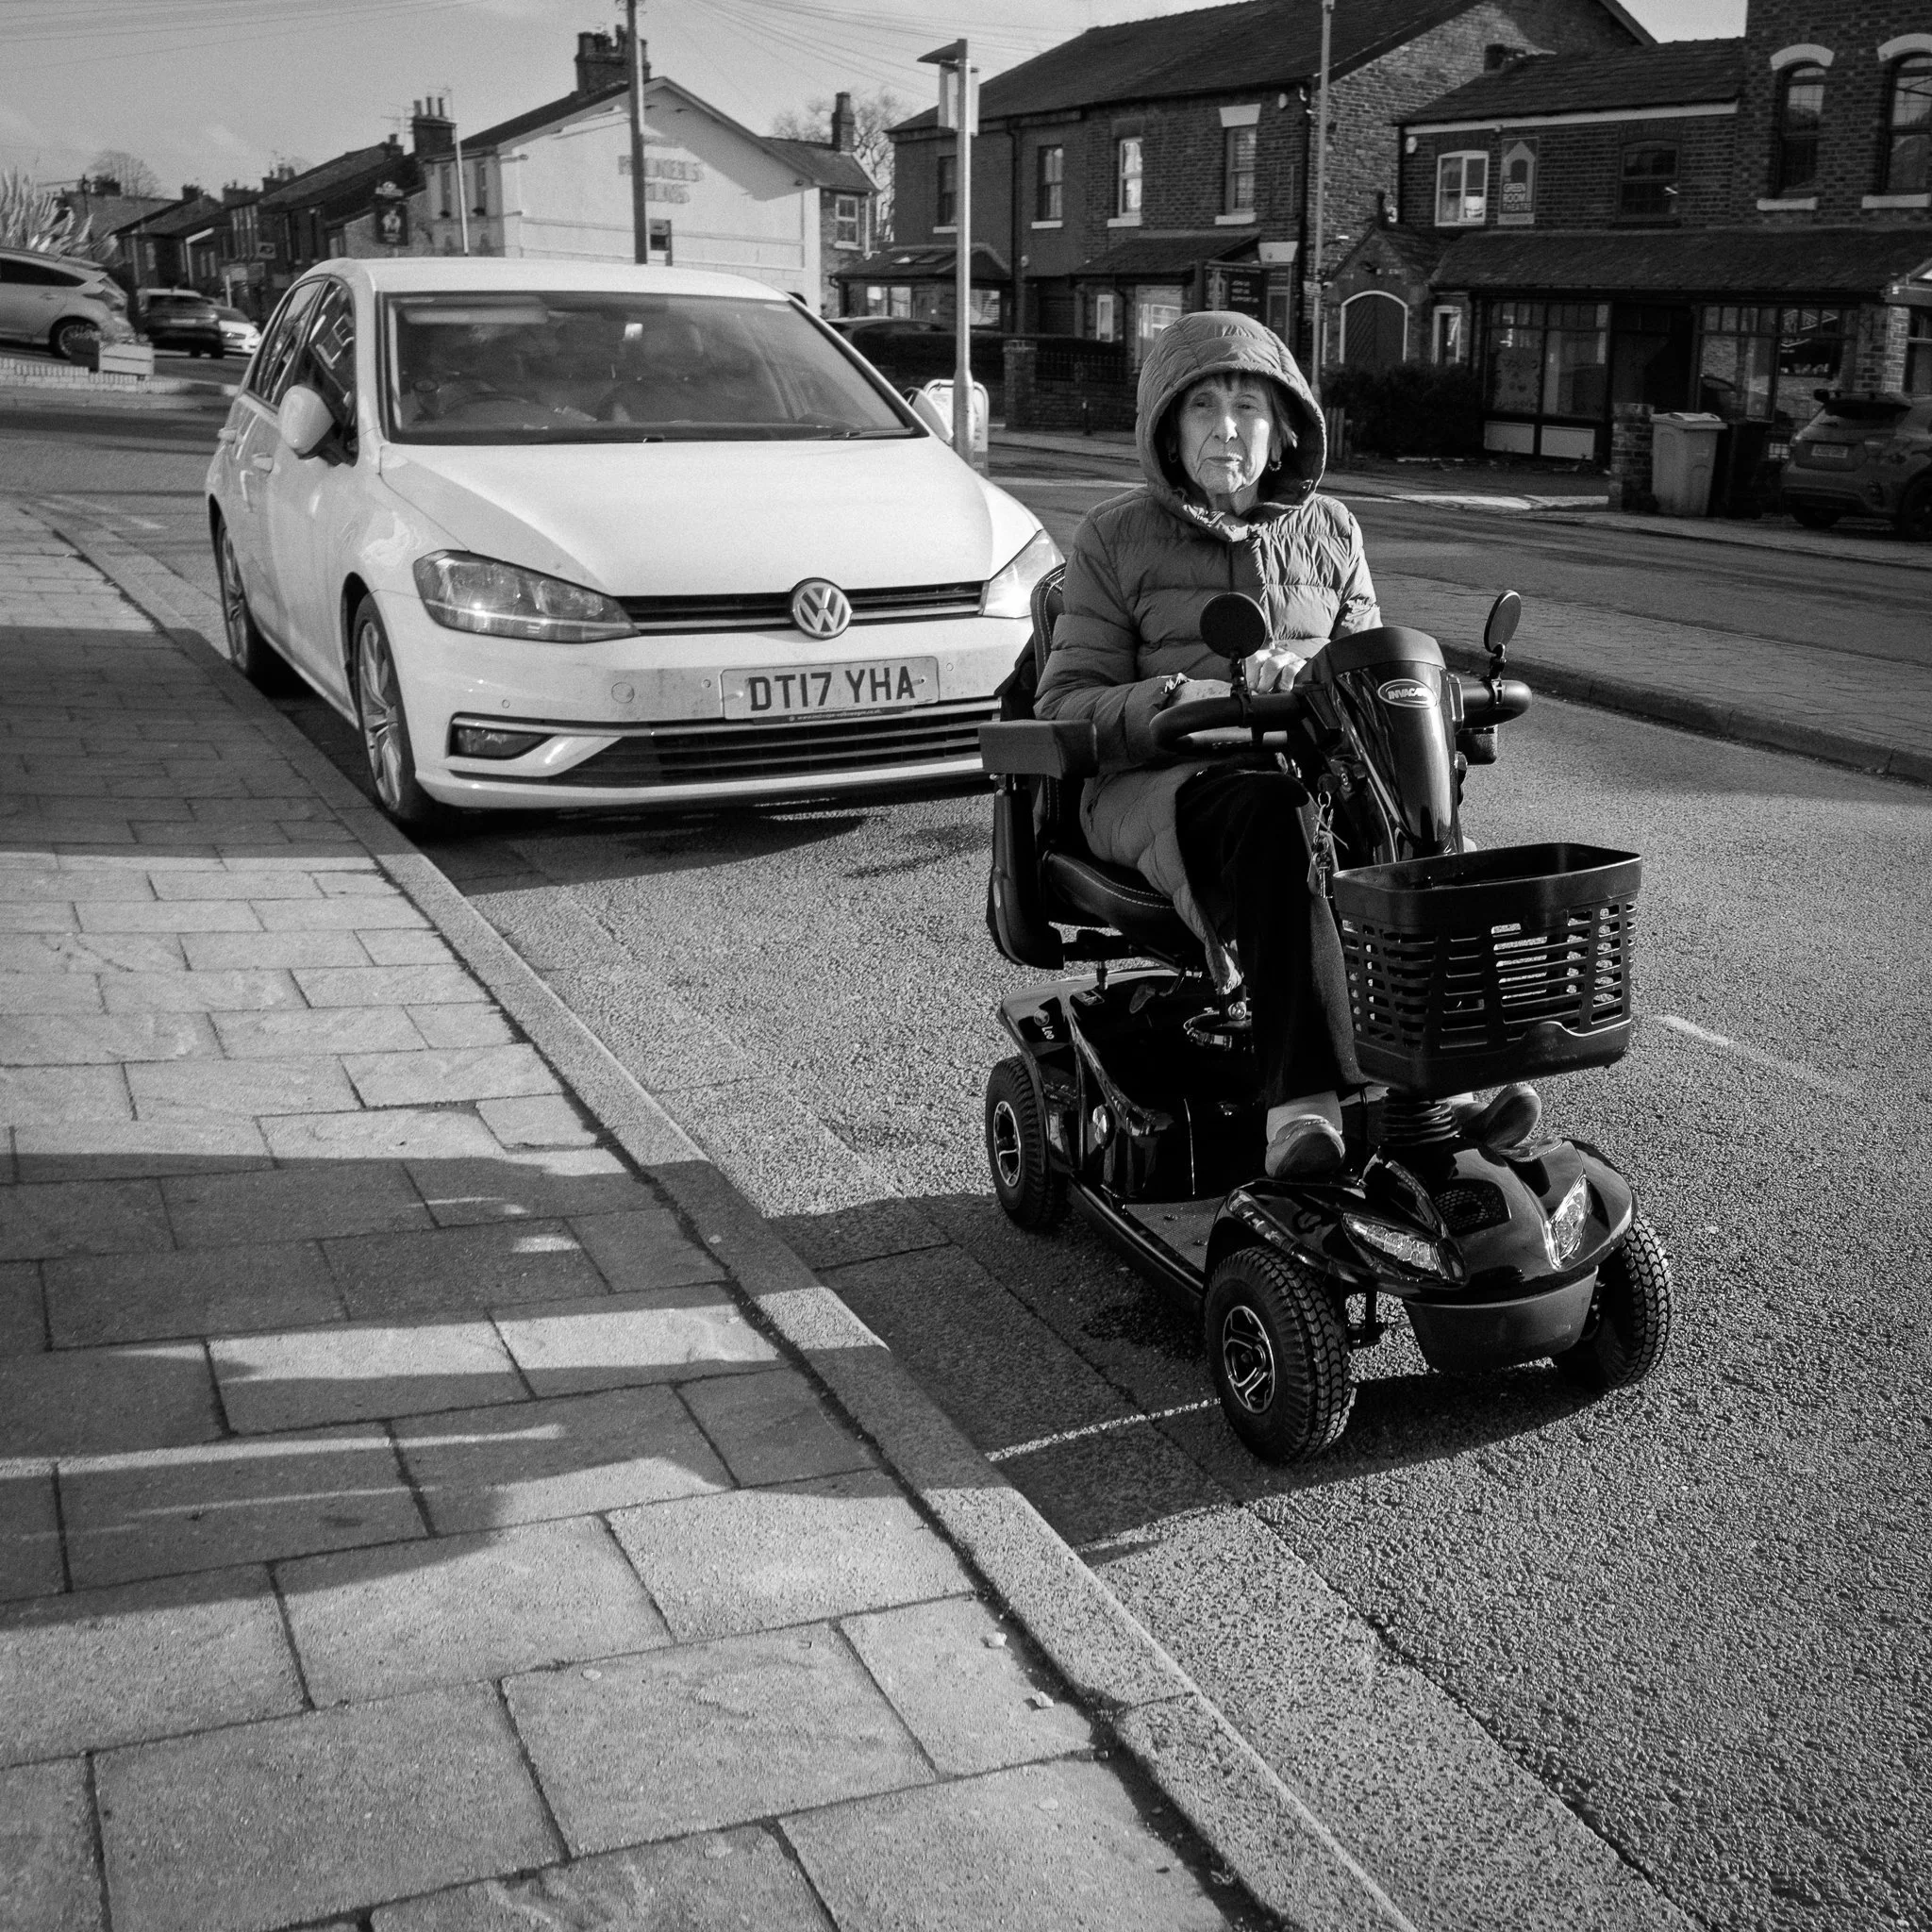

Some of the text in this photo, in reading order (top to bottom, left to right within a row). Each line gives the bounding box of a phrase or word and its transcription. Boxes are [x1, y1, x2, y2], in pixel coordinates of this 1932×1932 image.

[1503, 182, 1526, 193] GREEN
[1502, 192, 1526, 204] ROOM
[749, 665, 916, 711] DT17 YHA
